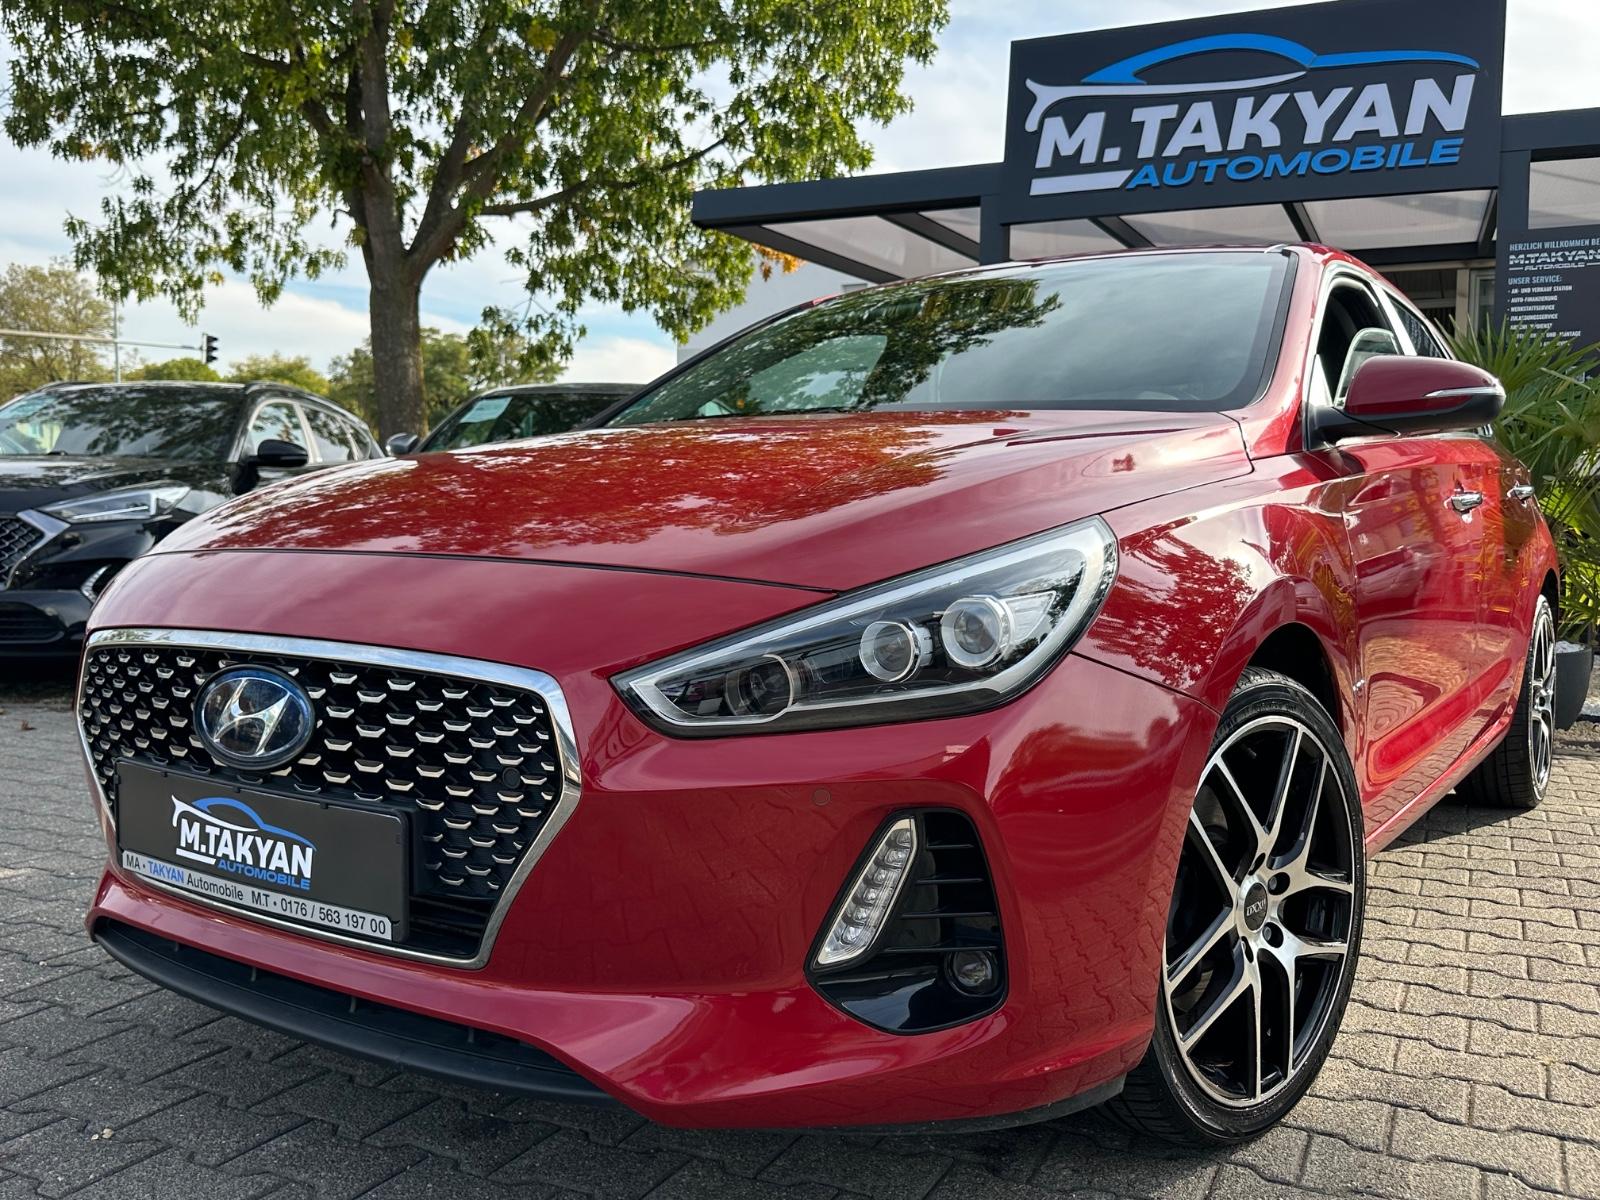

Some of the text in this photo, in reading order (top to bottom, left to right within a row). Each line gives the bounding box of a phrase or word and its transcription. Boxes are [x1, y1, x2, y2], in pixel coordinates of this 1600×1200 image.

[1125, 138, 1464, 190] AUTOMOBILE
[1509, 242, 1542, 251] HERZLICH
[1544, 239, 1590, 249] WILLKOMMEN
[1508, 274, 1562, 286] UNSER SERVICE:
[1524, 262, 1585, 271] AUTOMOBILE
[180, 818, 313, 879] M.TAKYAN
[217, 859, 311, 891] AUTOMOBILE
[126, 853, 141, 870] MA
[148, 861, 184, 884] TAKYAN
[187, 871, 243, 901] Automobile
[281, 899, 307, 917] 0176
[319, 907, 341, 925] 563
[345, 913, 366, 931] 197
[370, 919, 386, 936] 00
